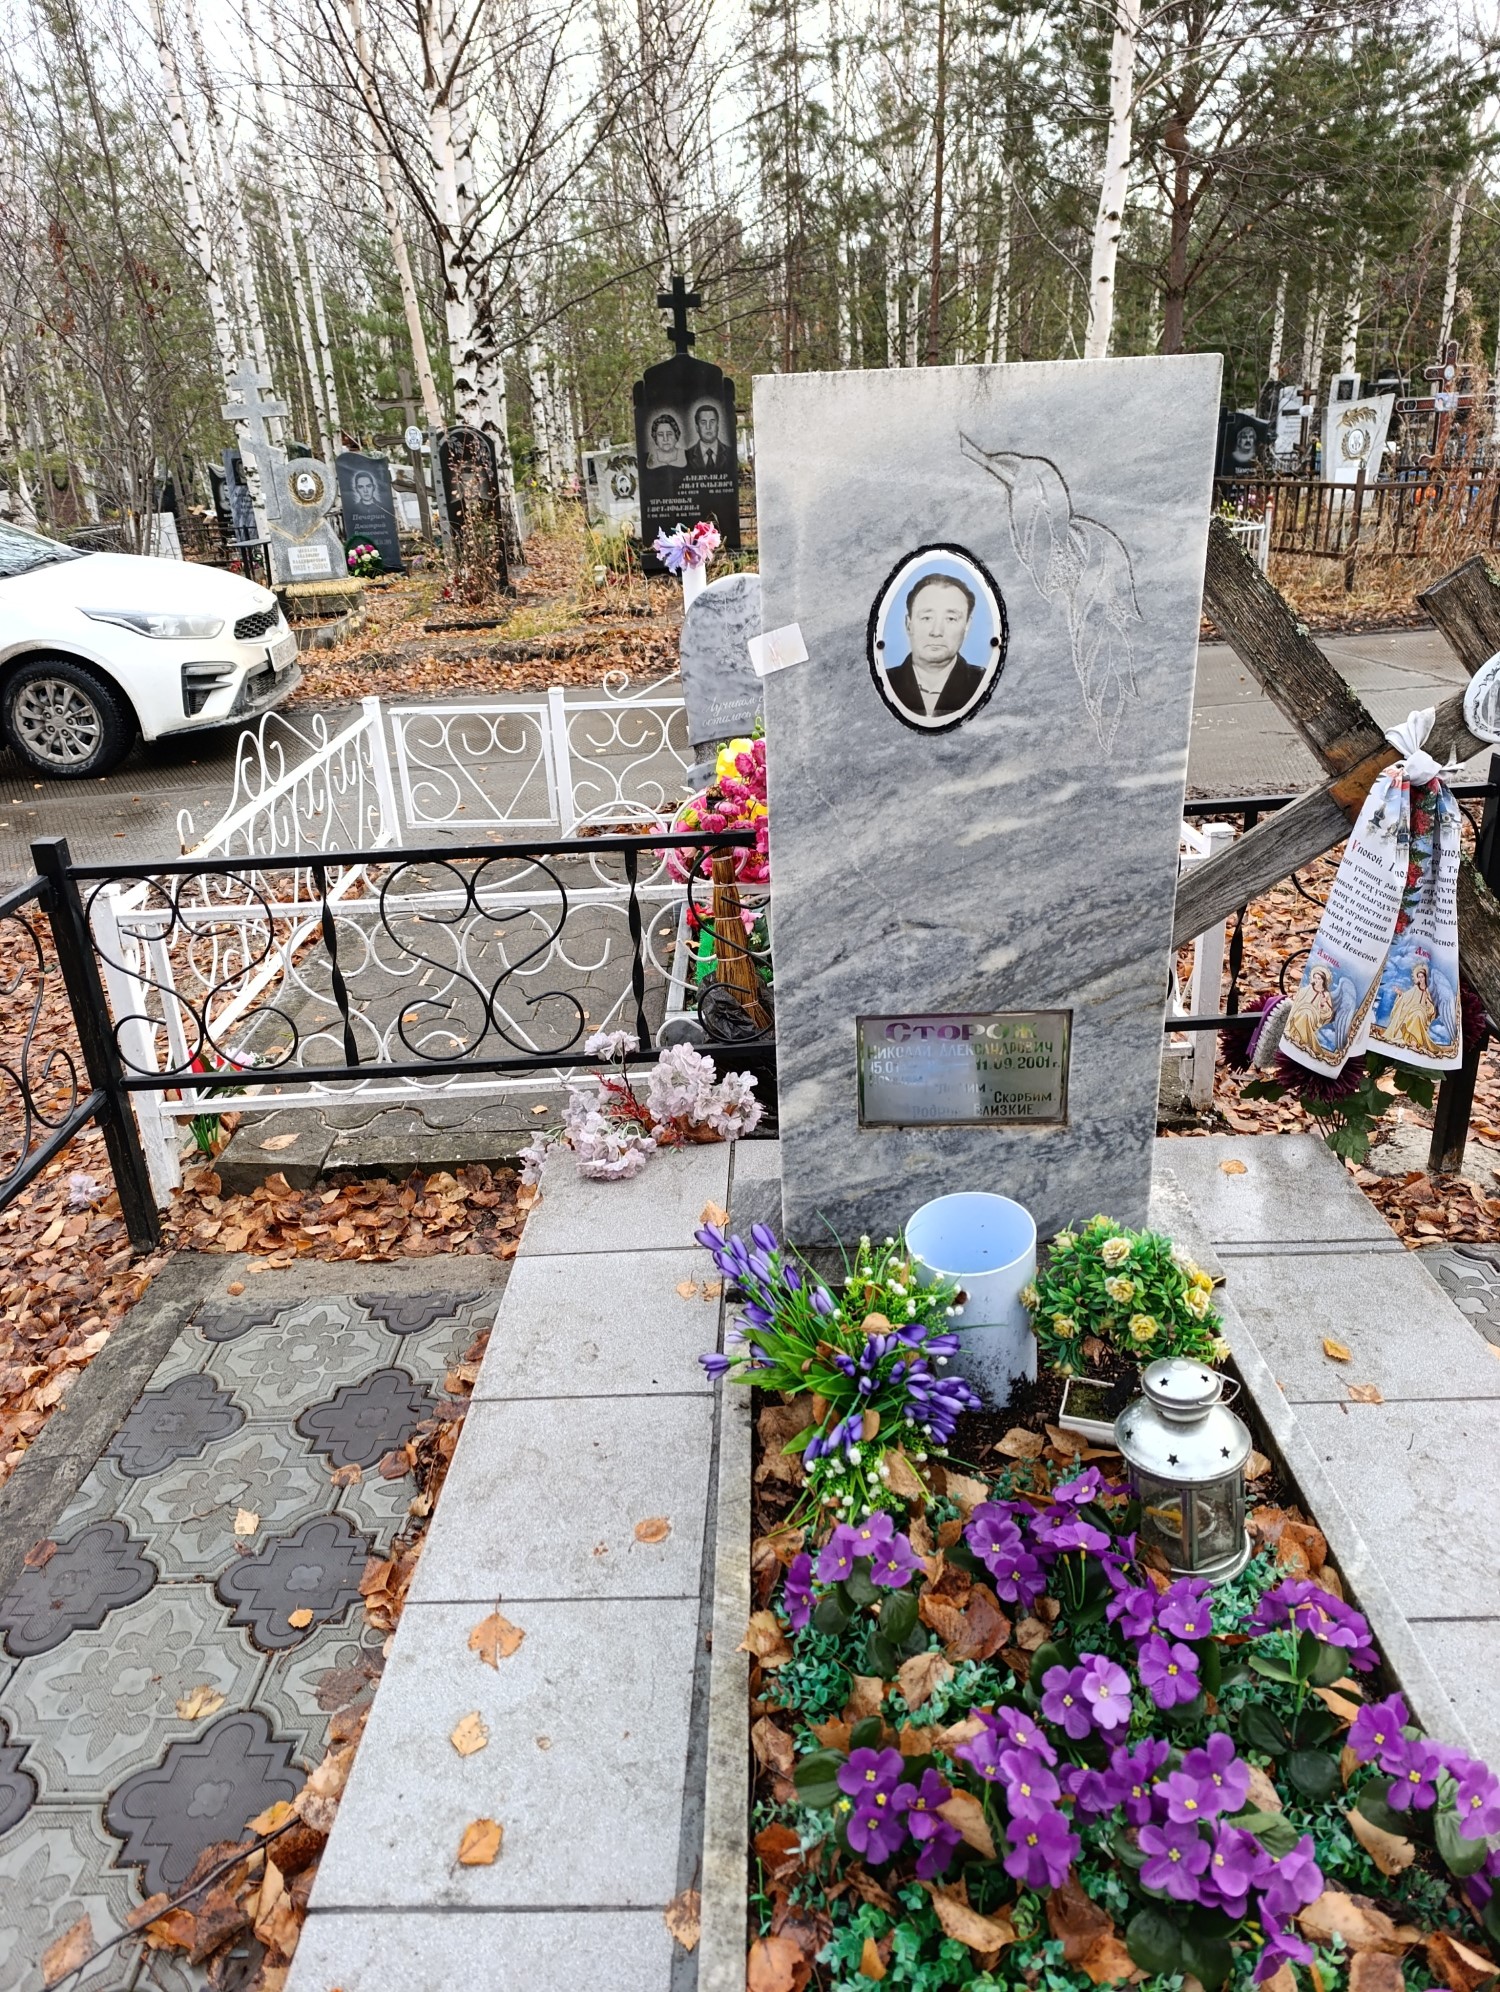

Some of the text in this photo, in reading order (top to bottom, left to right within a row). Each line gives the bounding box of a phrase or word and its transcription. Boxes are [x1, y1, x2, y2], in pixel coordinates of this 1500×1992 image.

[1351, 839, 1384, 868] Упокой,
[1344, 908, 1388, 932] согрешения
[1355, 901, 1383, 920] прости
[867, 1041, 1053, 1060] НИКОЛАЙ АЛЕКСАНДРОВИЧ
[976, 1056, 1050, 1071] 11.09.2001
